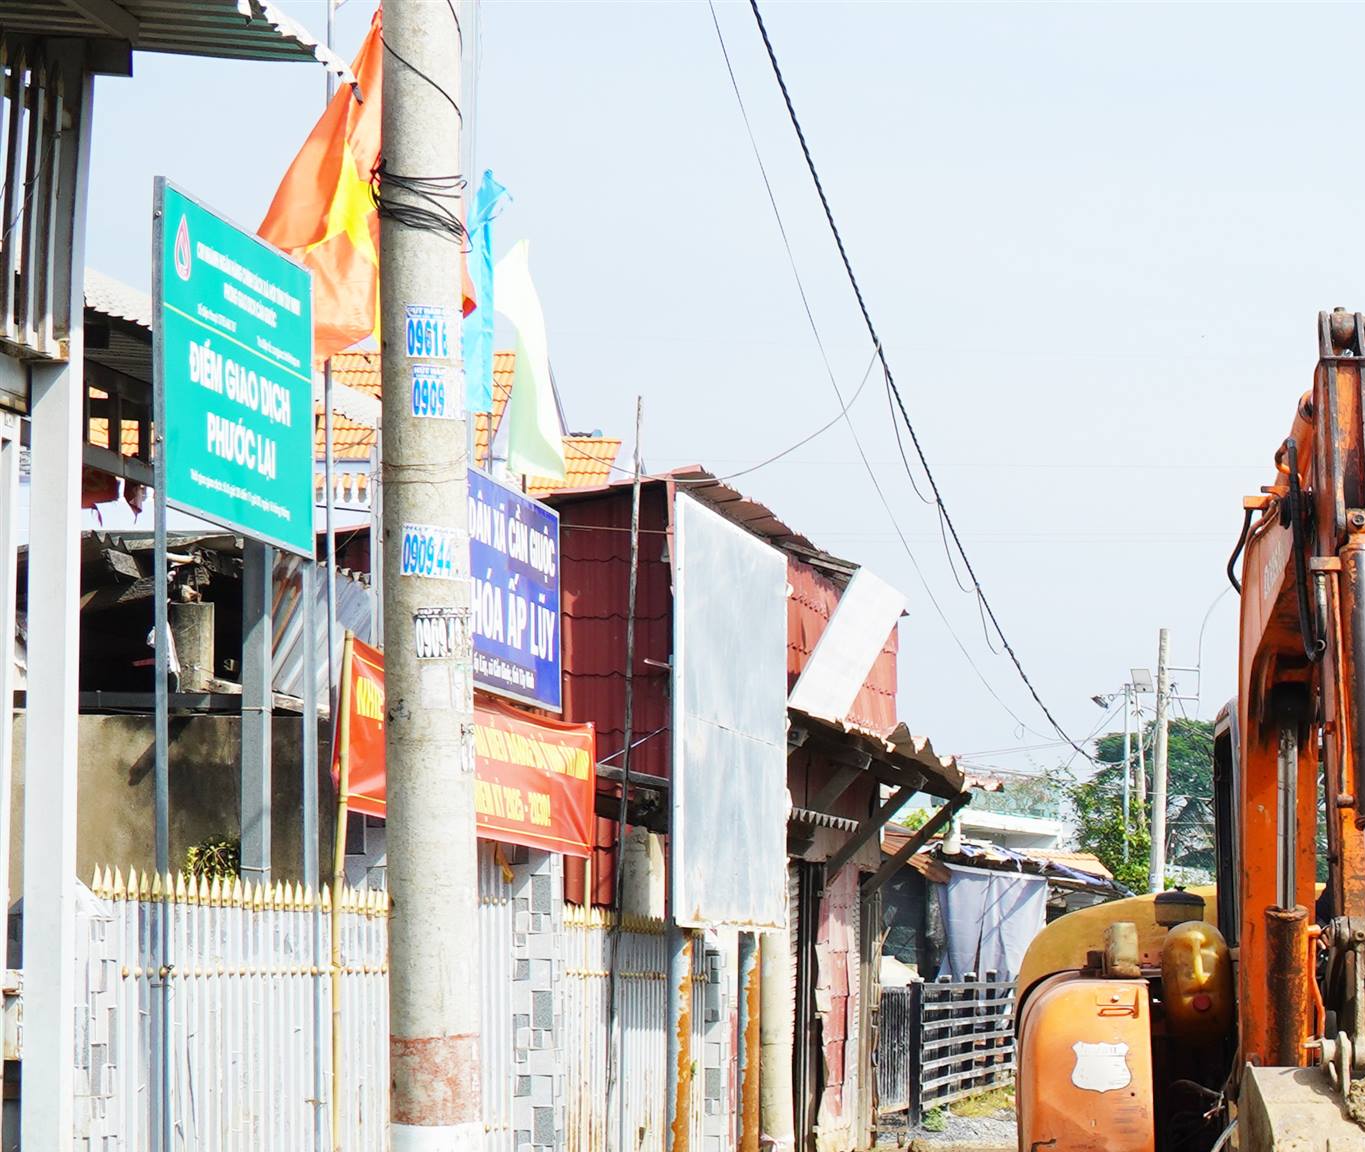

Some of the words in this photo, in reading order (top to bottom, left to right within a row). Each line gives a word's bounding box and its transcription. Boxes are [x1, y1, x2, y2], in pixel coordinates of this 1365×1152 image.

[225, 359, 259, 411] GIAO
[260, 376, 291, 427] DỊCH
[207, 411, 256, 470] PHƯỚC
[257, 433, 276, 481] LẠI
[469, 490, 491, 543] DÂN
[493, 503, 507, 555] XÃ
[529, 525, 556, 584] GIUỘC
[471, 568, 504, 643] HÓA
[507, 574, 527, 650] ẤP
